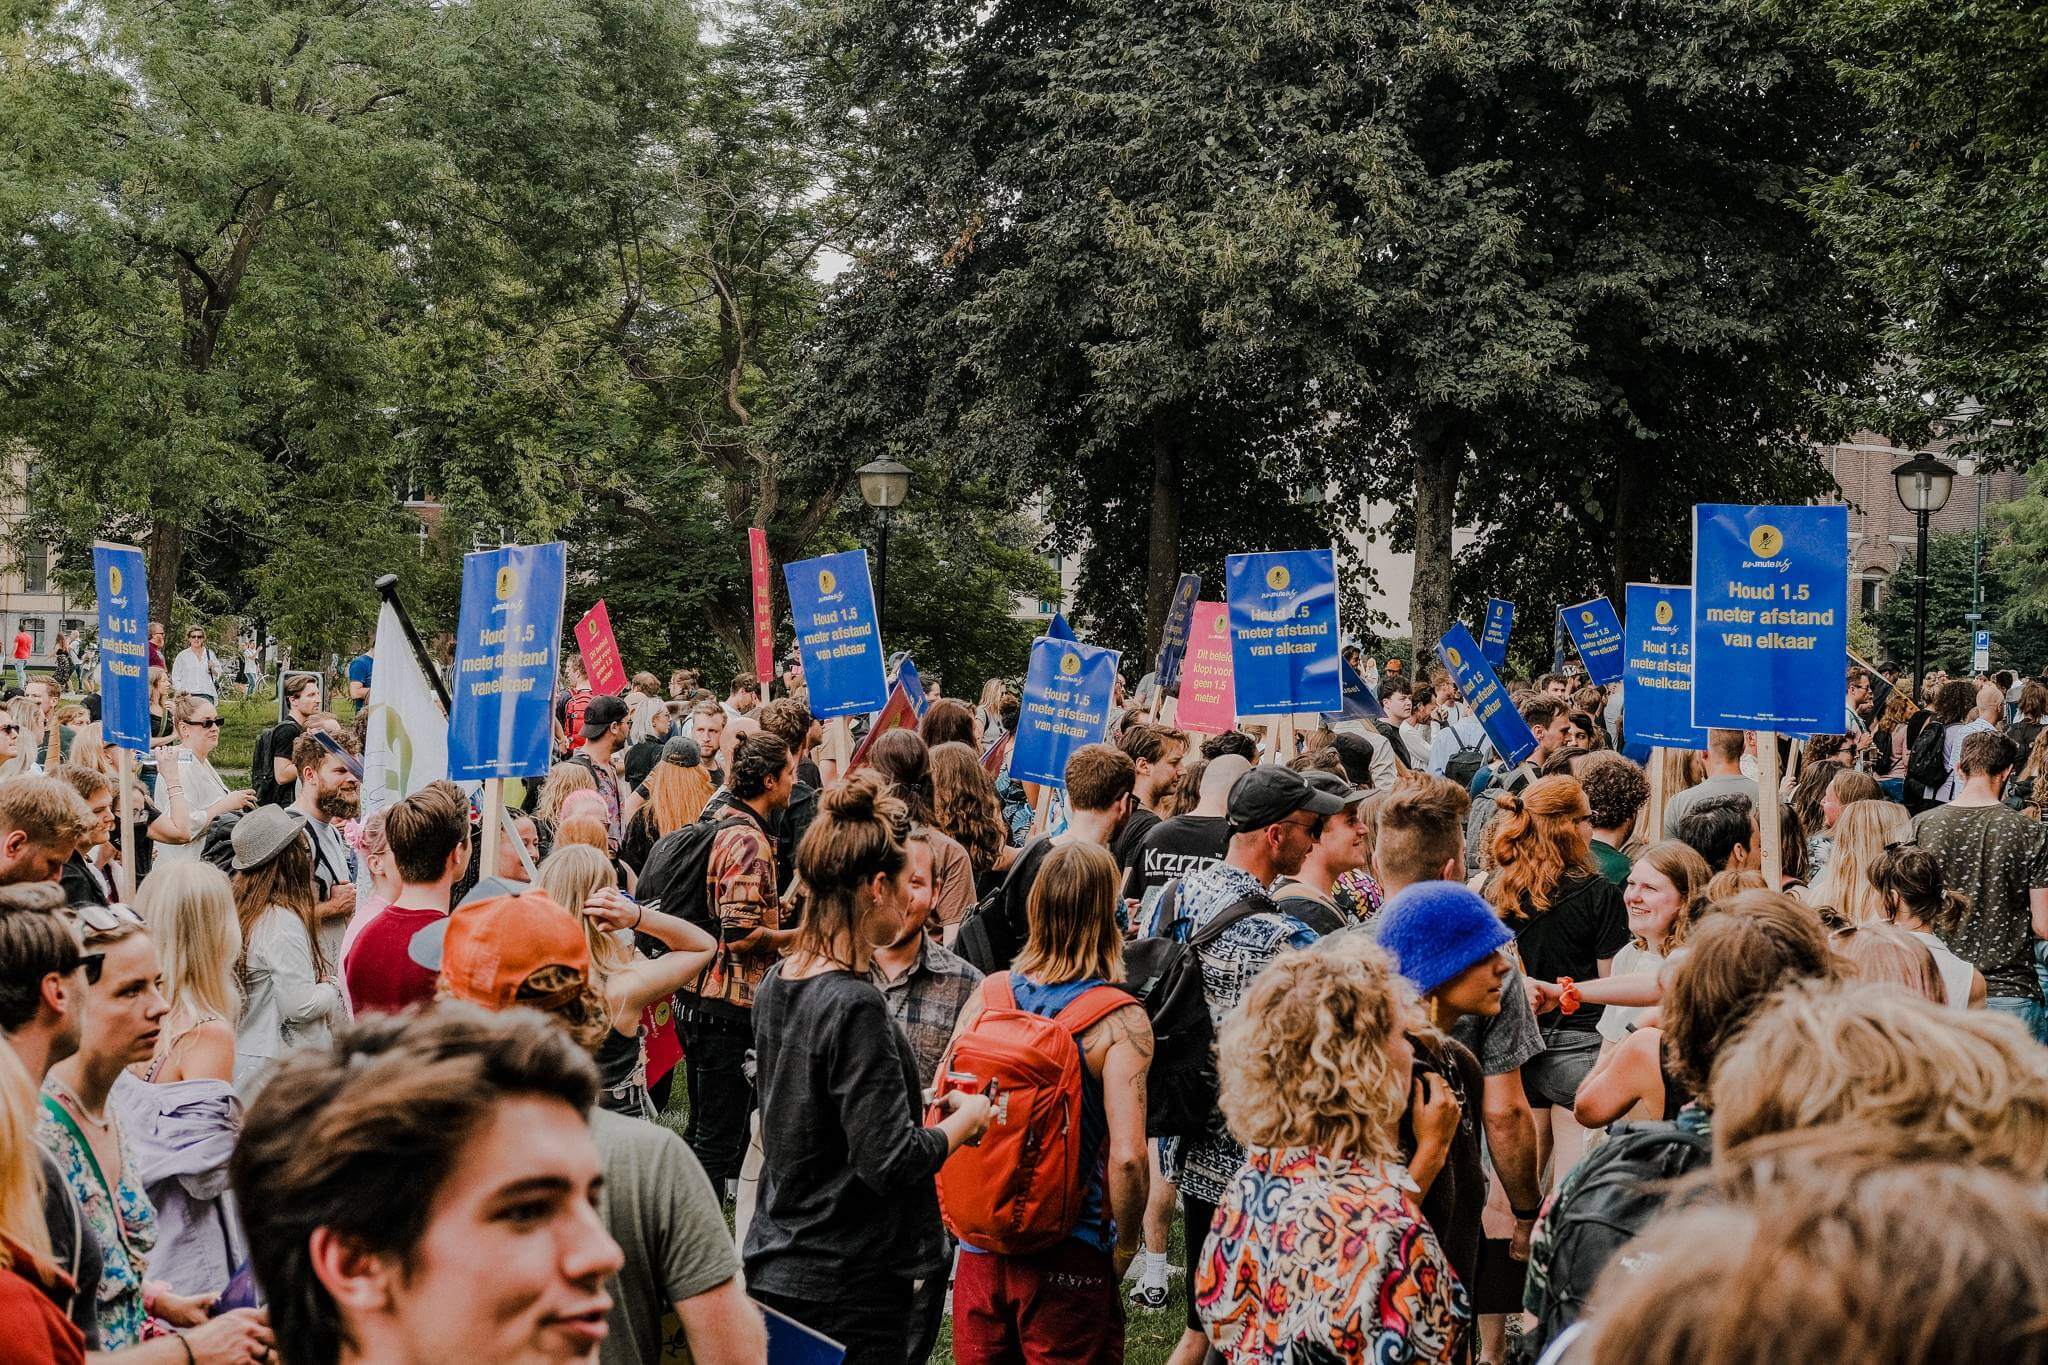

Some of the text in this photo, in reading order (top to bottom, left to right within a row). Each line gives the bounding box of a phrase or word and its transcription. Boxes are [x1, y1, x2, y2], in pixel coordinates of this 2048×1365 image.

[1728, 581, 1810, 601] Houd 1.5
[813, 607, 858, 626] Houd 1.5
[1251, 605, 1310, 622] Houd 1.5
[1706, 606, 1835, 626] meter afstand
[122, 617, 137, 634] 1.5
[512, 624, 535, 642] 1.5
[804, 622, 872, 646] meter afstand
[1238, 622, 1328, 640] meter afstand
[1721, 632, 1818, 650] van elkaar
[1978, 633, 1986, 644] P
[815, 643, 866, 661] van elkaar
[1197, 648, 1208, 659] Dit
[1250, 642, 1318, 657] van elkaar
[1642, 640, 1689, 656] Houd 1.5
[495, 648, 549, 668] afstand
[1630, 657, 1656, 670] meter
[1193, 662, 1233, 677] klopt voor
[1193, 679, 1227, 691] geen 1.5
[1638, 675, 1655, 687] van
[1655, 676, 1691, 691] elkaar
[1044, 687, 1090, 707] Houd 1.5
[1194, 692, 1220, 705] meter!
[1028, 702, 1100, 725] meter afstand
[1034, 719, 1088, 738] van elkaar
